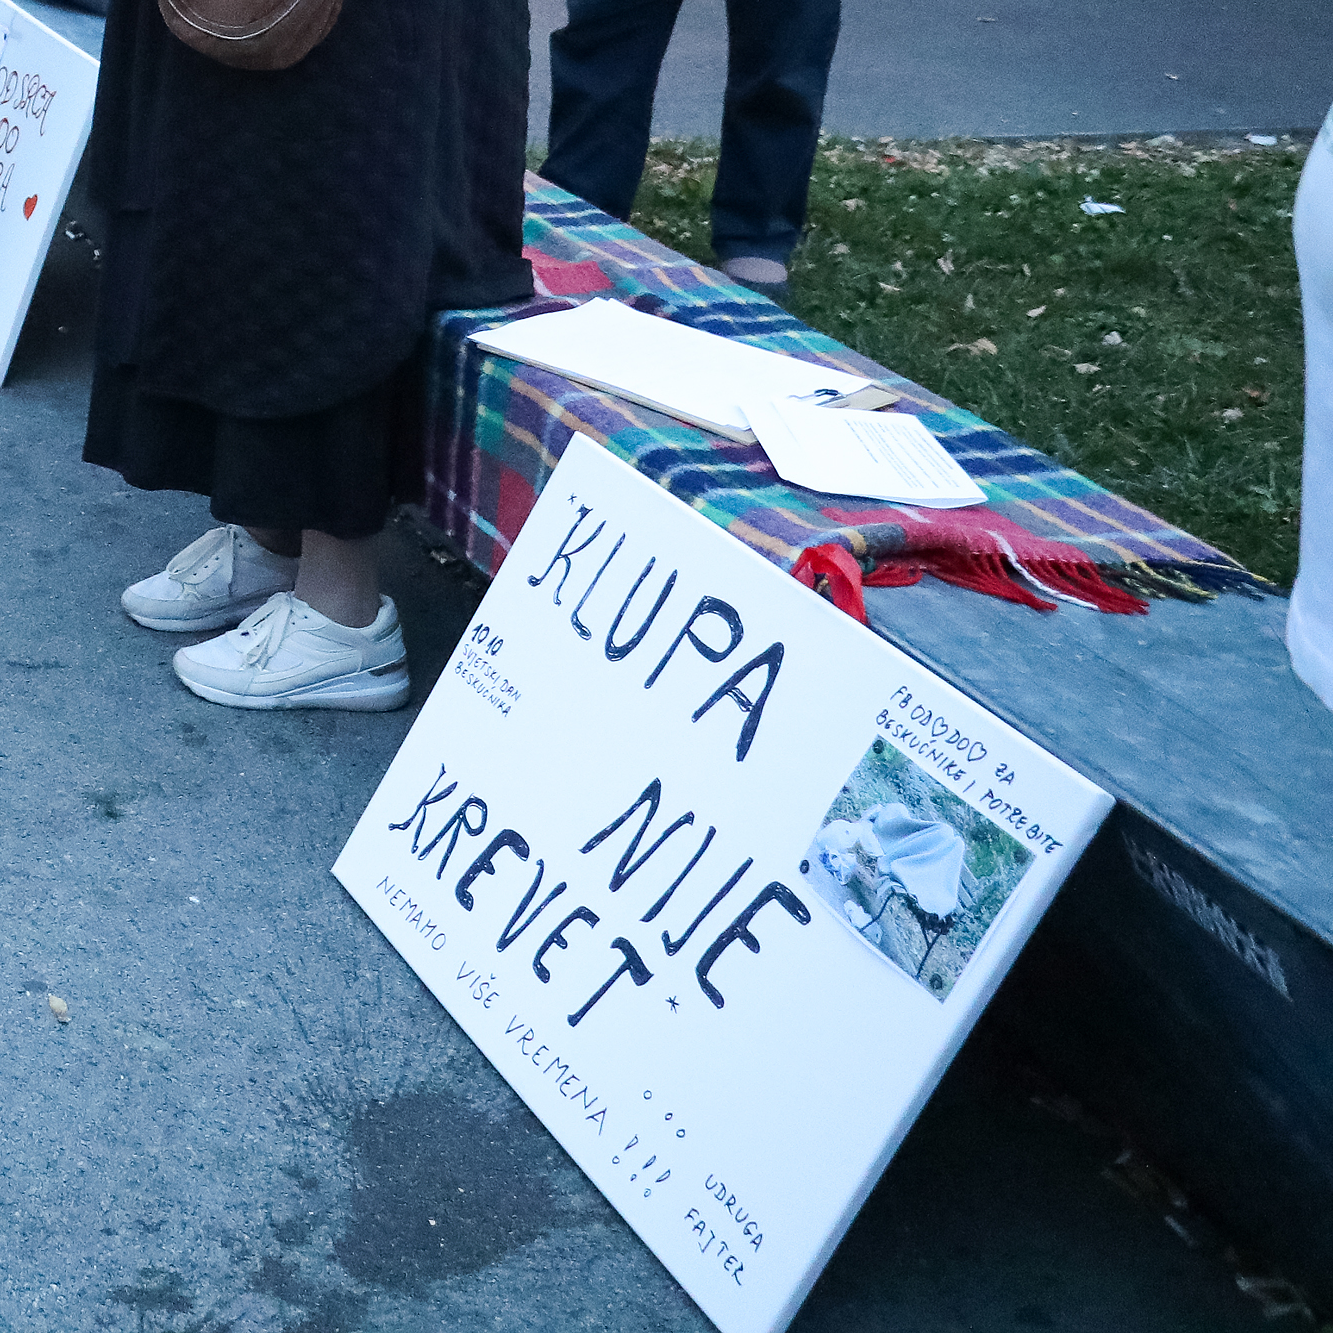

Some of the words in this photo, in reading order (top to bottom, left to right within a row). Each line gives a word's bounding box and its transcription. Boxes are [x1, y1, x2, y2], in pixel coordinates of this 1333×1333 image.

[462, 643, 501, 685] SVJETSKI
[499, 678, 522, 702] DAN
[526, 503, 785, 763] KLUPA
[375, 875, 447, 951] NEMAMO
[456, 960, 500, 1010] VIŠE
[504, 1014, 608, 1134] VREMENA
[387, 762, 655, 1028] KREVET
[577, 776, 812, 1010] NIJE
[683, 1207, 744, 1287] FAJTER
[704, 1173, 763, 1253] UDRUGA
